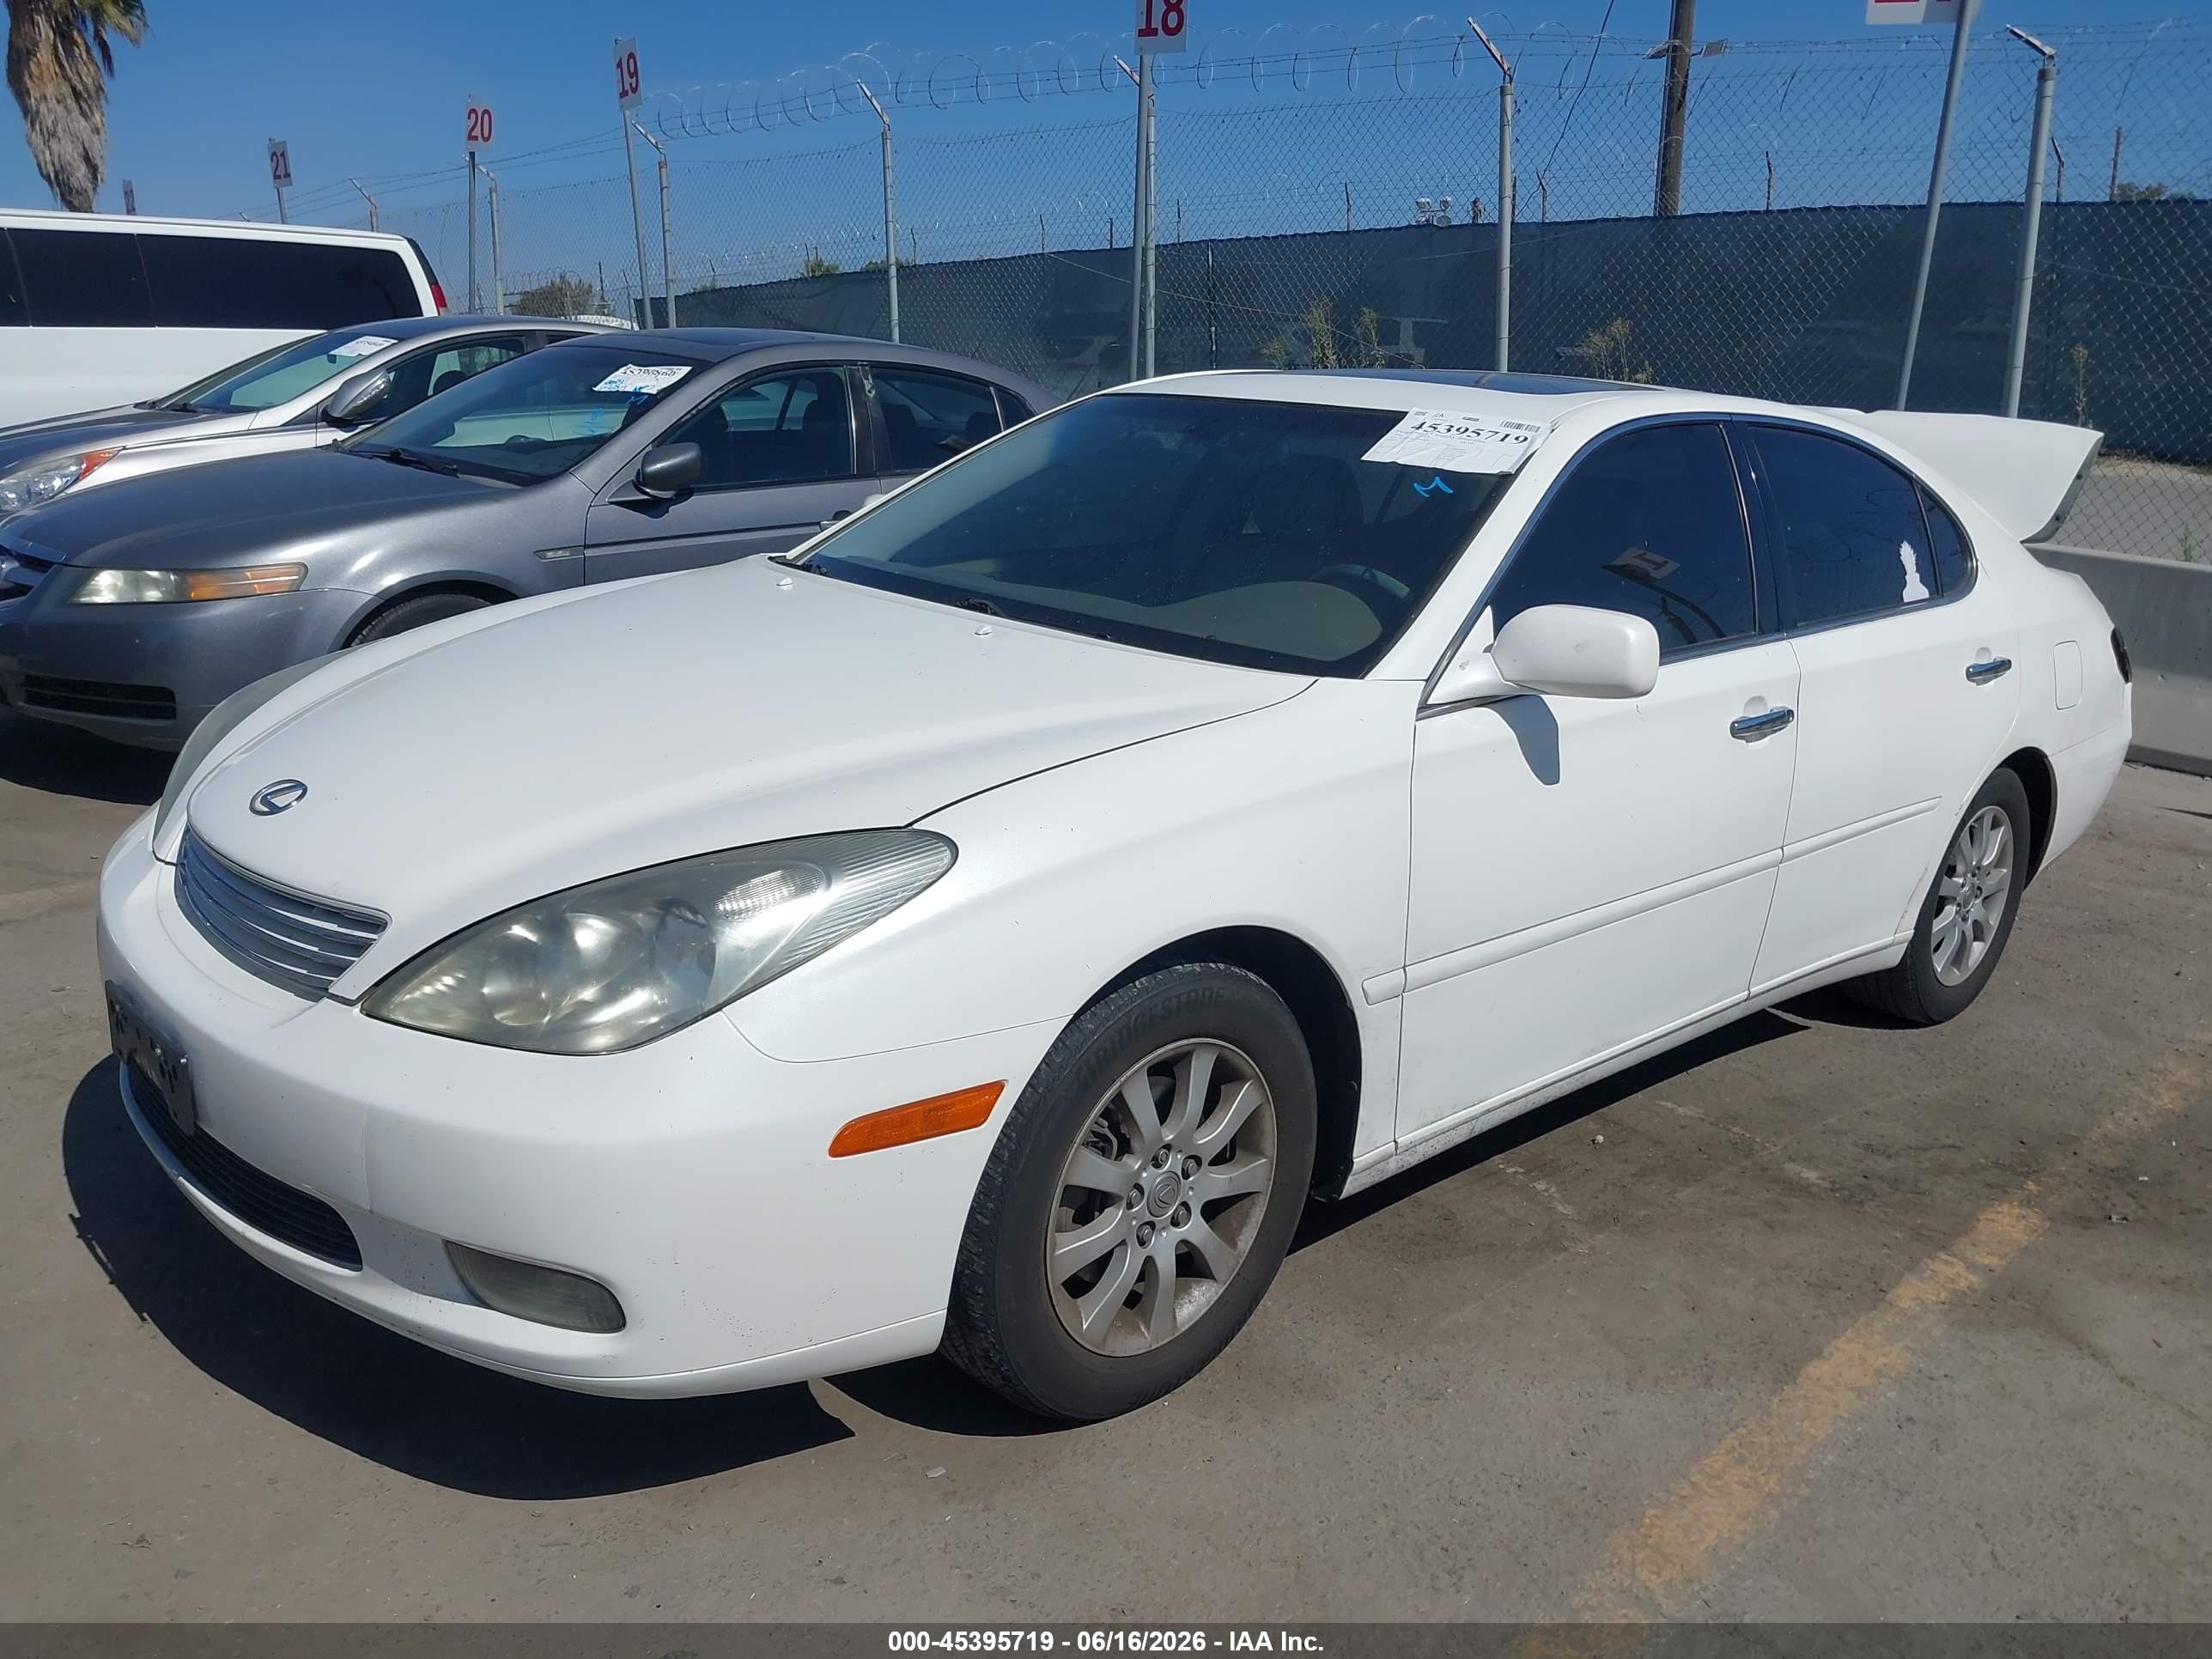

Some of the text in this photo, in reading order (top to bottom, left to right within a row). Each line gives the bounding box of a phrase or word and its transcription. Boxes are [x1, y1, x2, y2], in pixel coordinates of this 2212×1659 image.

[1138, 0, 1184, 37] 18
[616, 52, 639, 99] 19
[467, 108, 493, 143] 20
[270, 150, 291, 179] 21
[1411, 421, 1528, 445] 45395719
